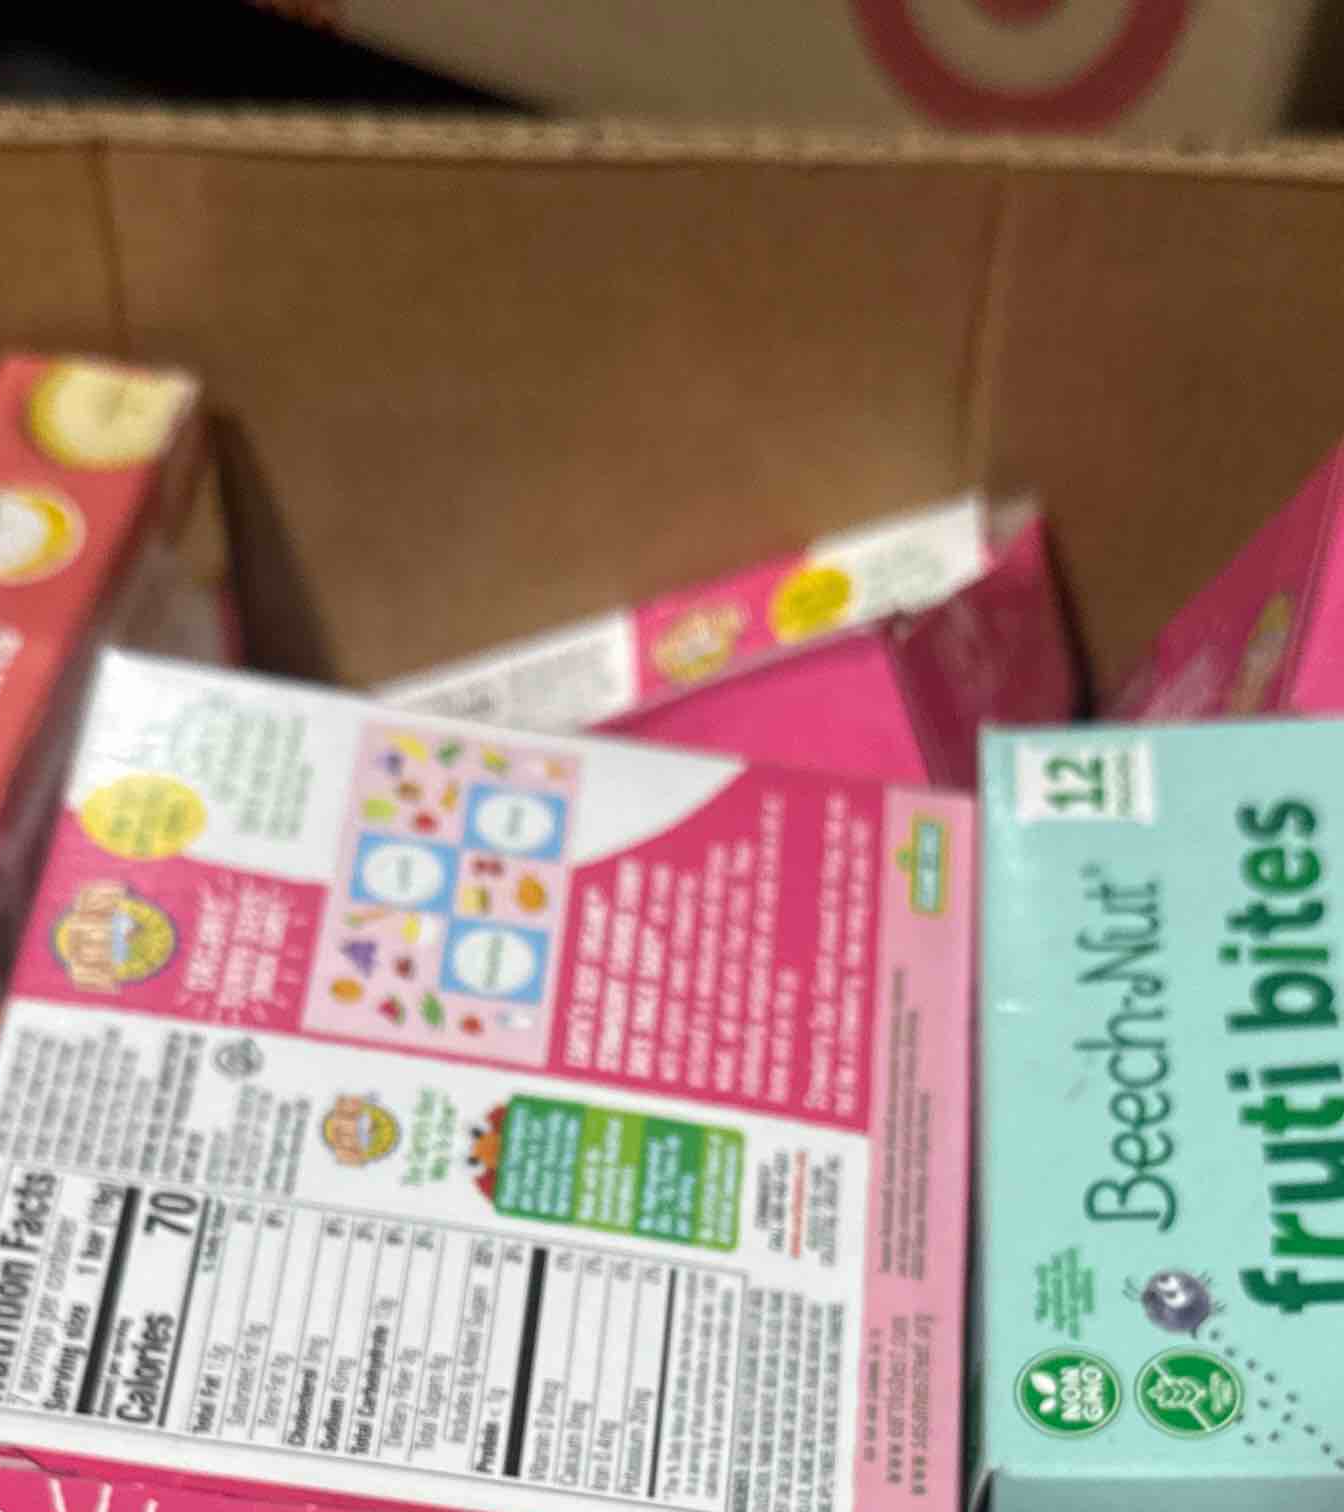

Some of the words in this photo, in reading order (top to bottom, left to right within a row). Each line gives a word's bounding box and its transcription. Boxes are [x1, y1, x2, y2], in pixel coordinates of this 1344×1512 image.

[1042, 755, 1107, 813] 12
[1218, 800, 1340, 1034] bites
[143, 1189, 199, 1237] 70
[115, 1312, 175, 1424] Calories
